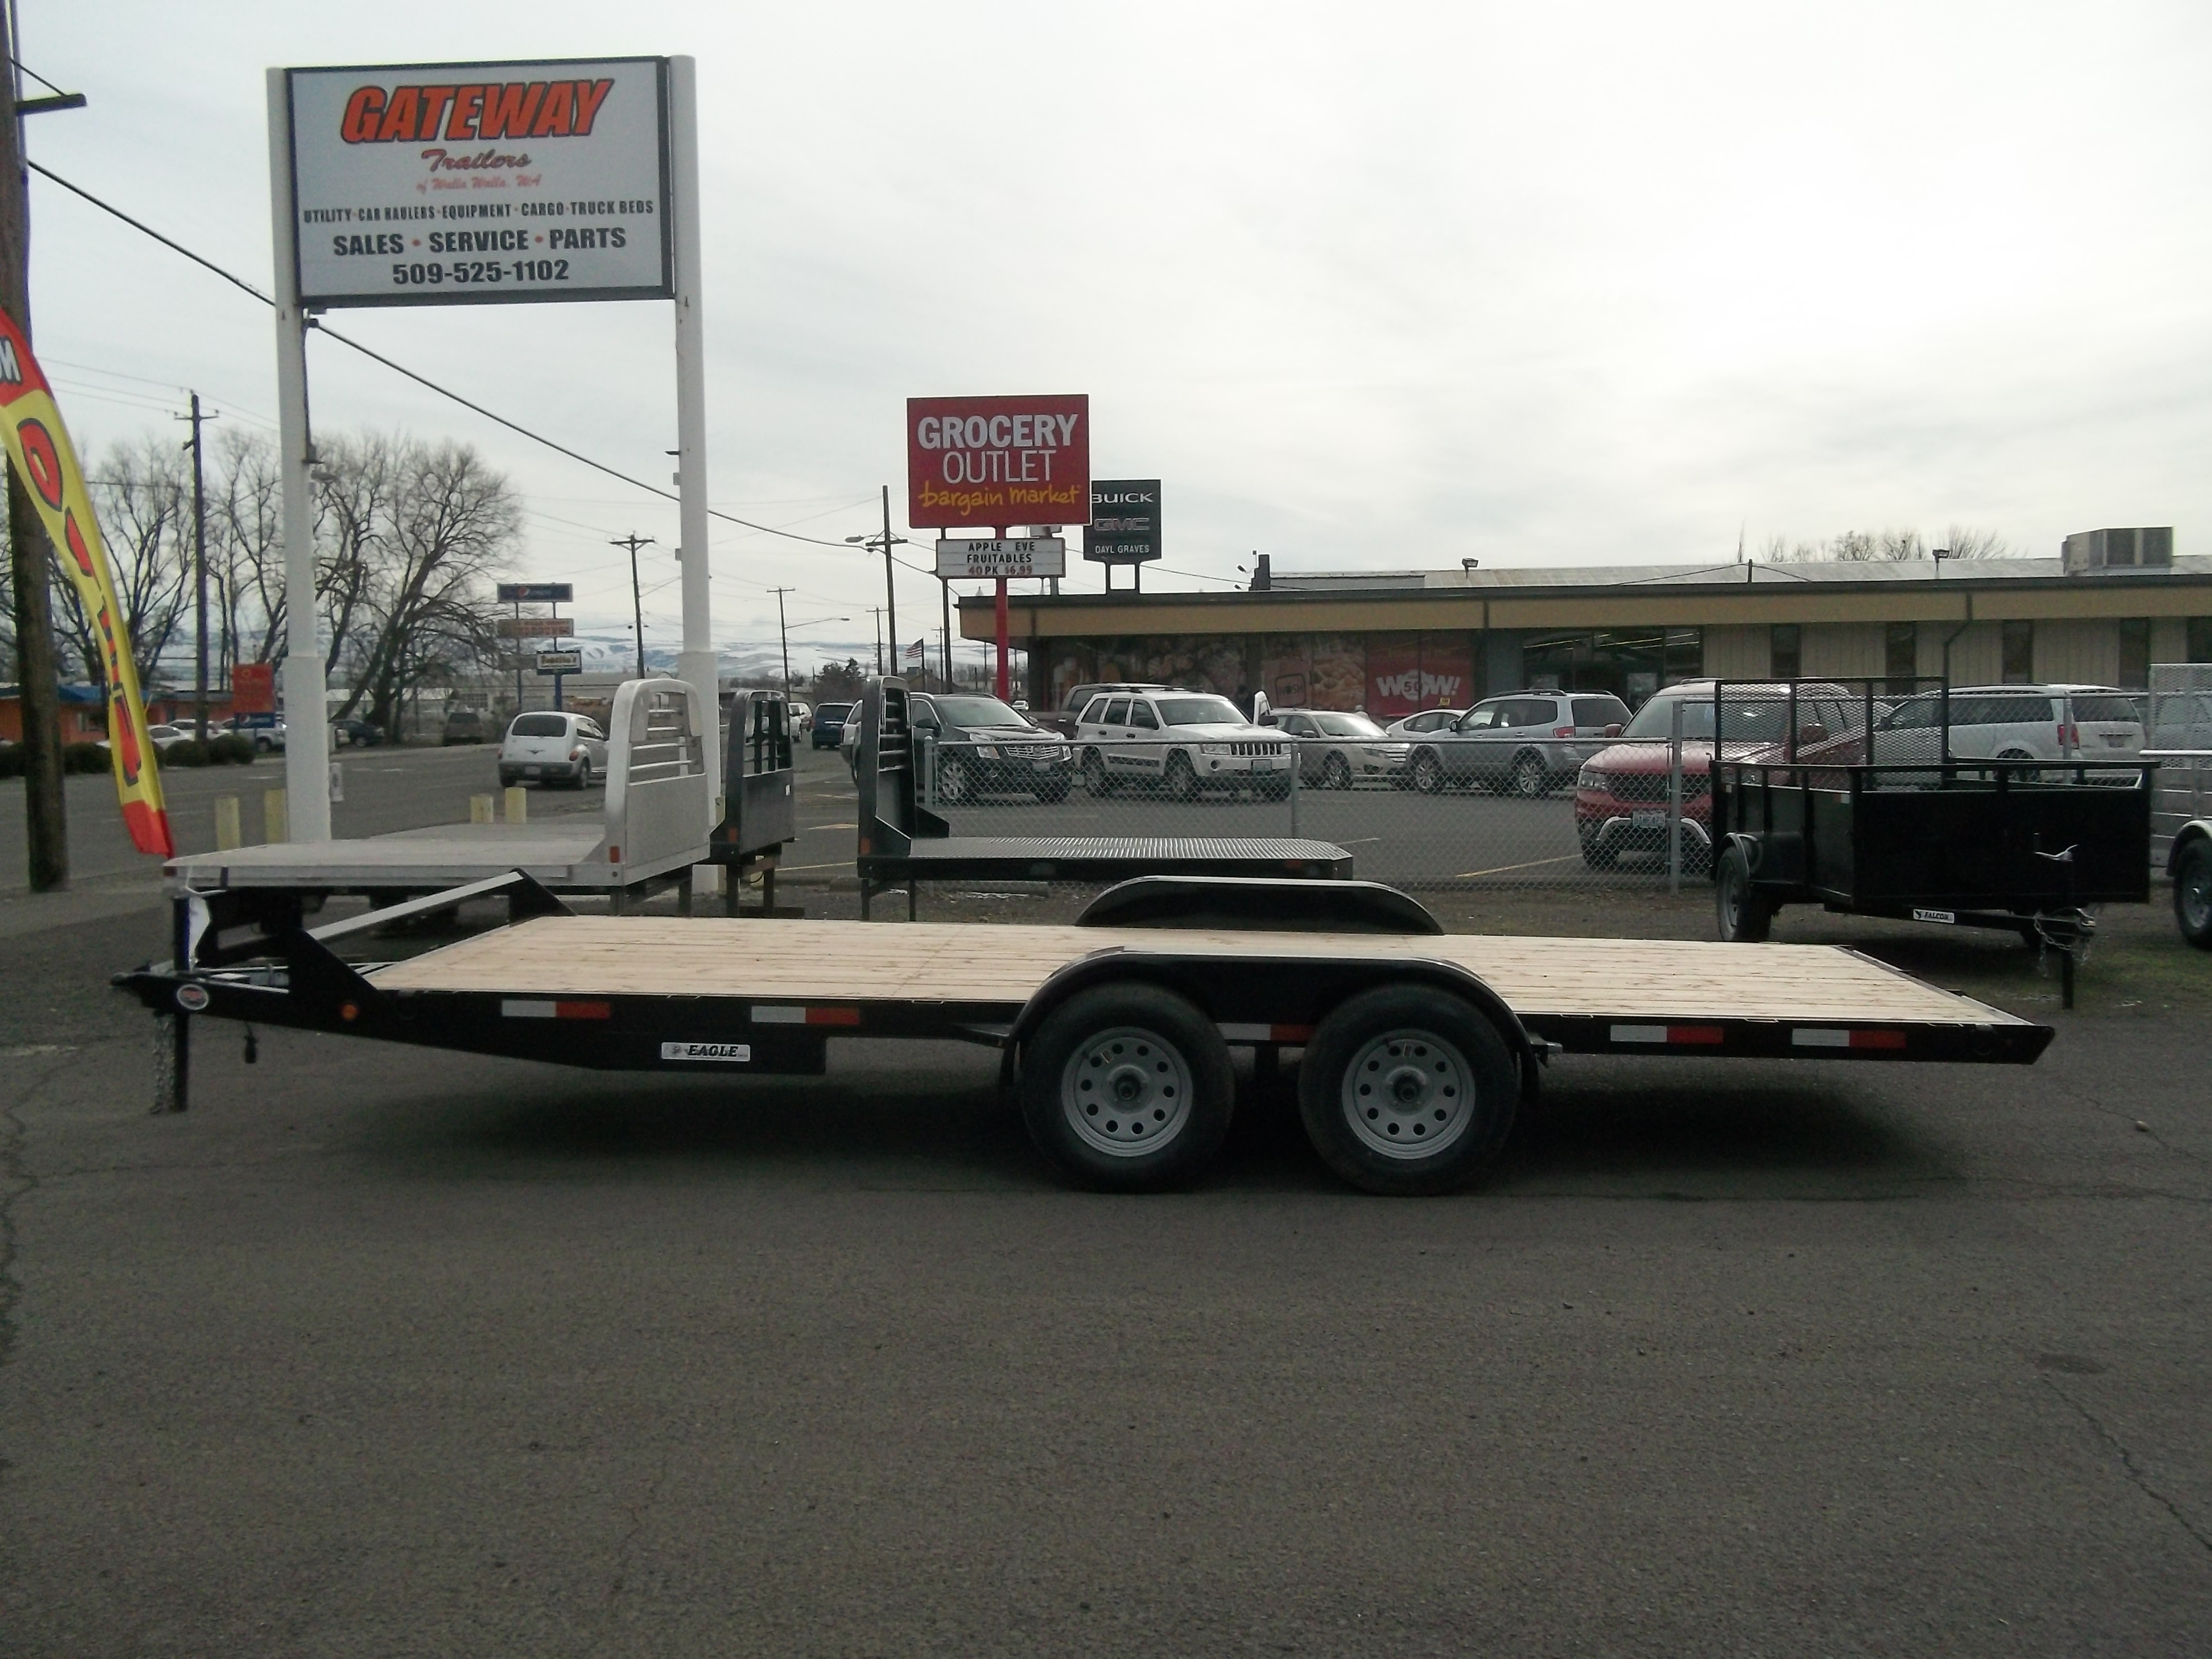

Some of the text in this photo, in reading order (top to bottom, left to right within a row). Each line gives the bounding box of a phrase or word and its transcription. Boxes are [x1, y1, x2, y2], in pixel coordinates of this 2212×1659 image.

[341, 78, 614, 144] GATEWAY
[421, 149, 532, 172] Trailers
[304, 200, 654, 223] UTILITY CAR HAULERS EQUIPMENT CARGO TRUCK BEDS
[333, 227, 627, 256] SALES SERVICE PARTS
[393, 259, 569, 285] 509-525-1102
[918, 414, 1078, 449] GROCERY
[943, 449, 1056, 483] OUTLET
[918, 480, 1079, 516] bargain market
[1092, 492, 1153, 503] BUICK
[1094, 517, 1150, 531] GMC
[968, 541, 1035, 551] APPLE EVE
[1095, 544, 1150, 554] DAYL GRAVES
[967, 553, 1032, 563] FRUITABLES
[1925, 912, 1949, 920] FALCON
[688, 1045, 739, 1057] EAGLE
